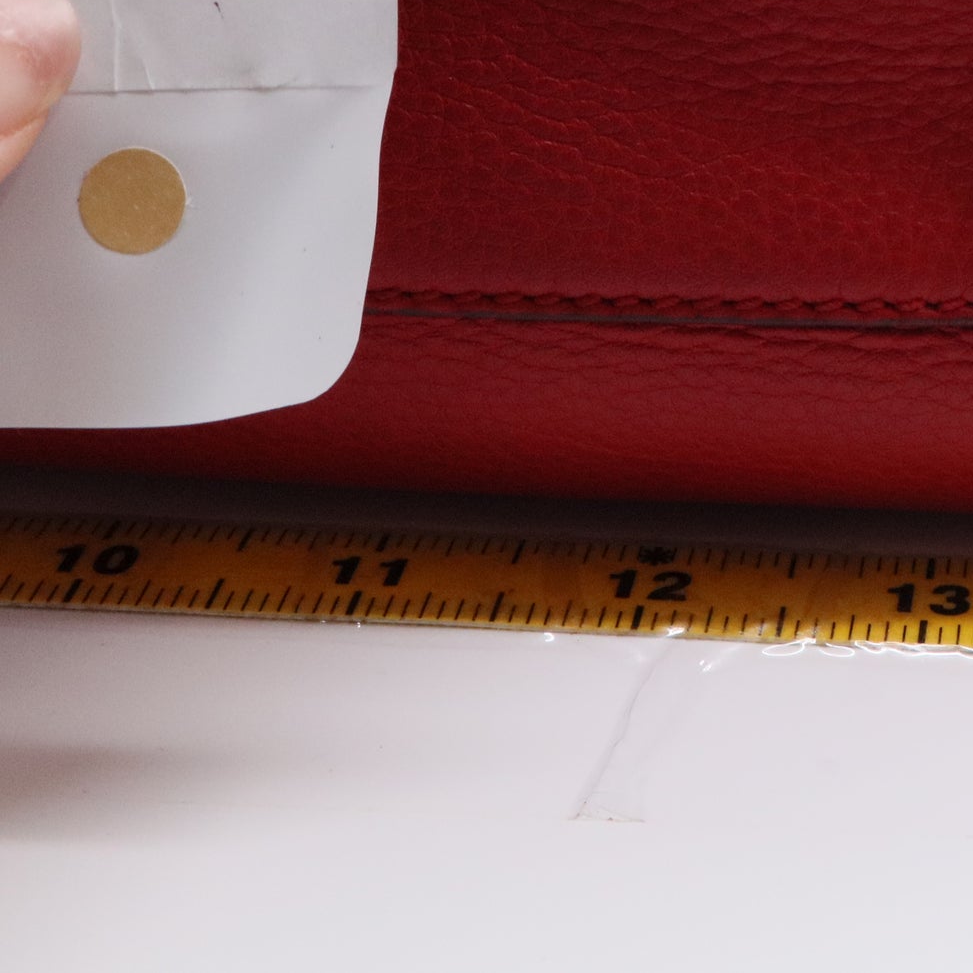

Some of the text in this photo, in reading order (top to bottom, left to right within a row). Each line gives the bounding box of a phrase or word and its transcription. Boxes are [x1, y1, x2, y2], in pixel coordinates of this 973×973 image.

[56, 544, 140, 575] 10
[331, 556, 409, 586] 11
[609, 569, 692, 601] 12
[887, 583, 972, 617] 13
